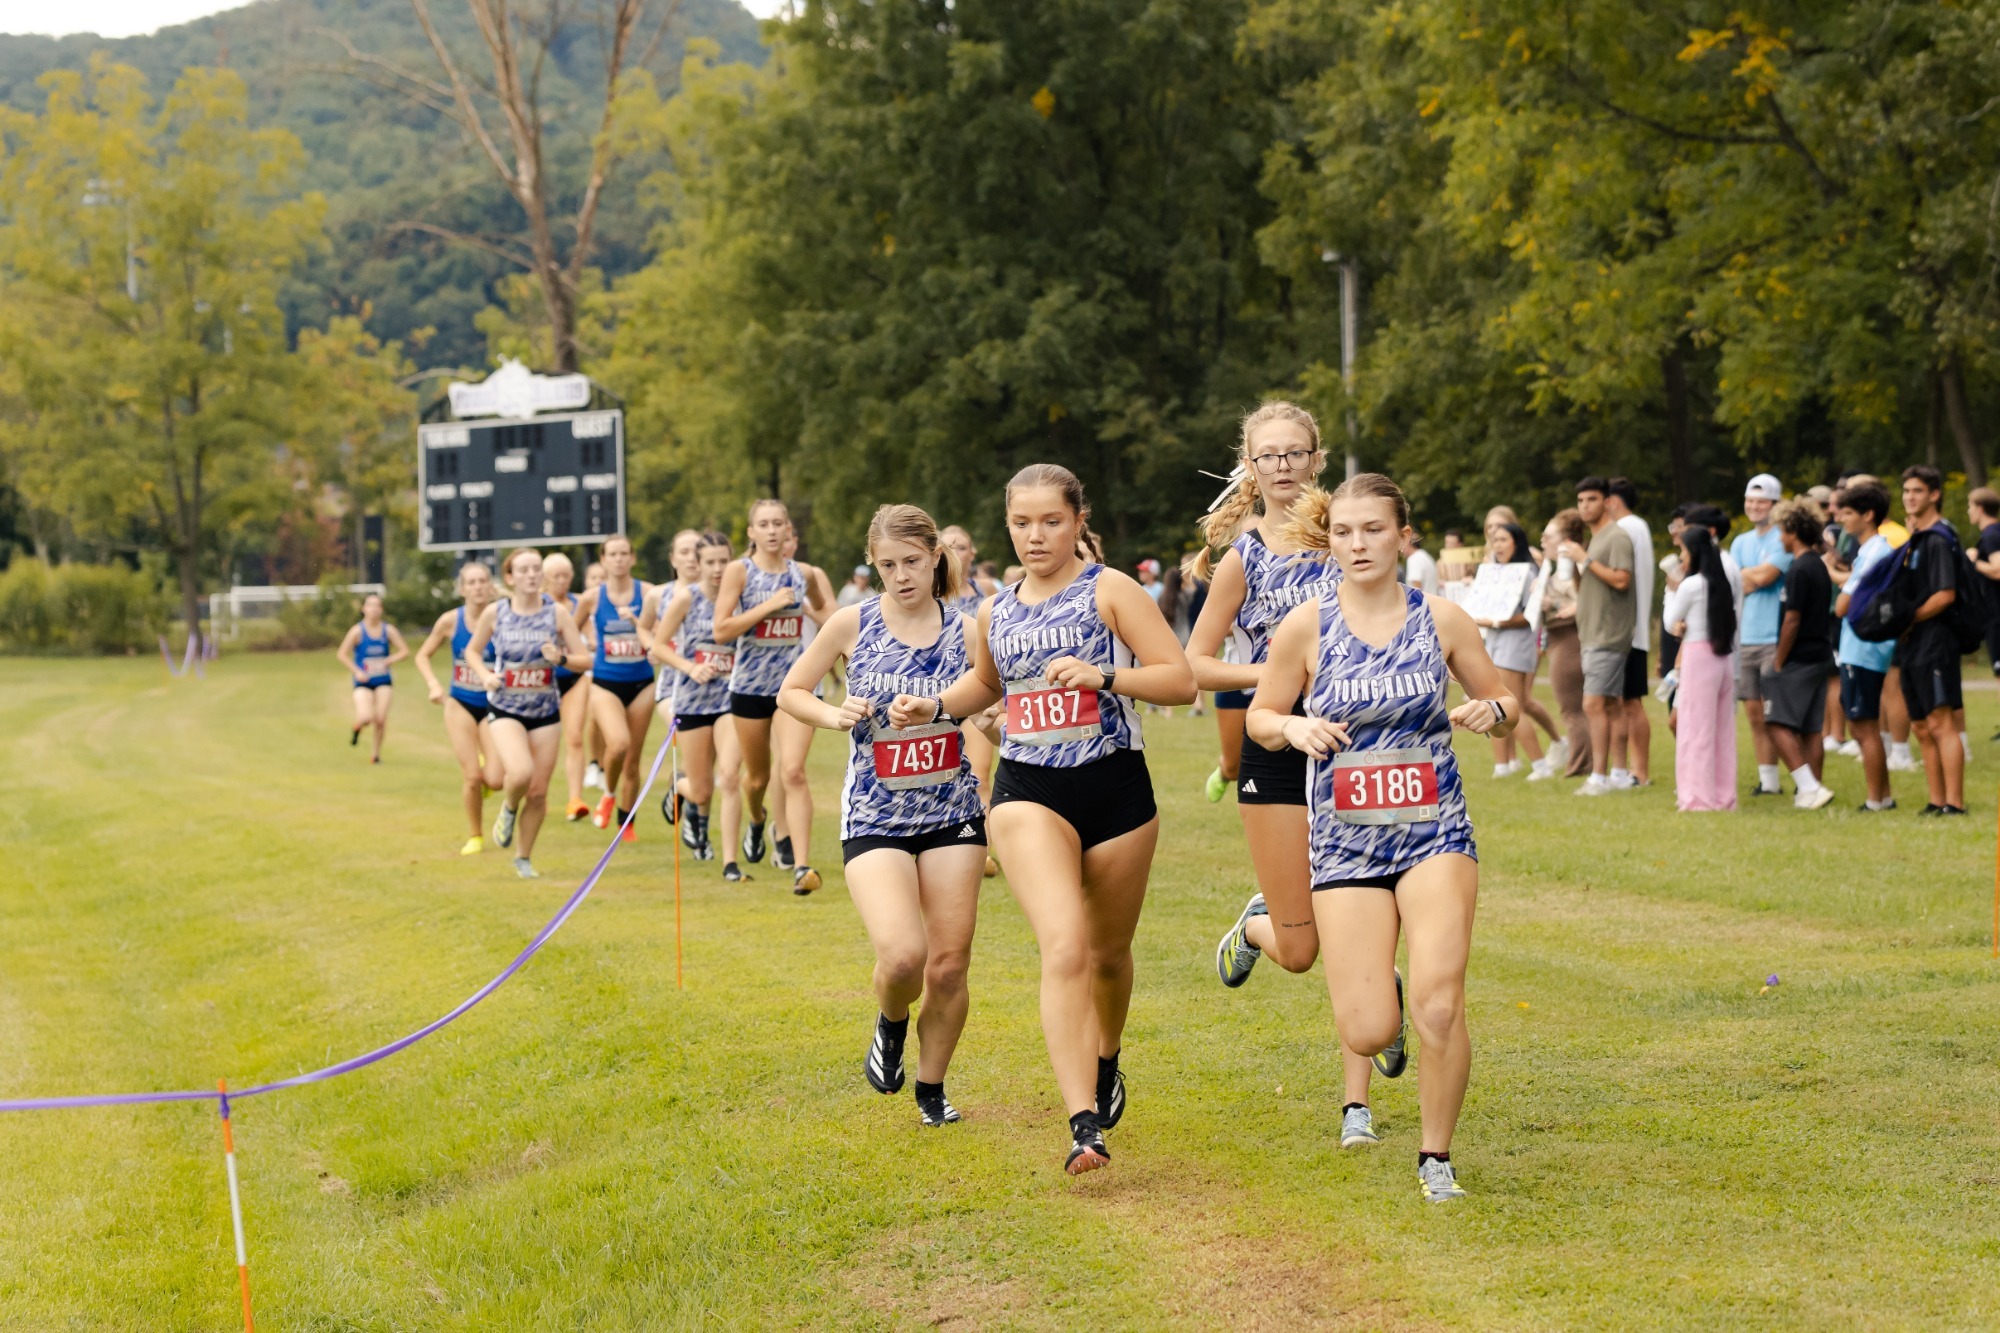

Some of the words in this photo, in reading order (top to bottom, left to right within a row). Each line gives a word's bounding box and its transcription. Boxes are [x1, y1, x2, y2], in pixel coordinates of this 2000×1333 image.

[1259, 585, 1301, 611] YOUNG
[1303, 578, 1341, 601] HARR
[764, 617, 798, 638] 7440
[1032, 625, 1084, 651] HARRIS
[511, 669, 546, 688] 7442
[868, 671, 908, 694] YOUNG
[1334, 678, 1379, 703] YOUNG
[1384, 670, 1437, 699] HARRIS
[1019, 690, 1080, 730] 3187
[887, 738, 947, 774] 7437
[1349, 767, 1423, 806] 3186
